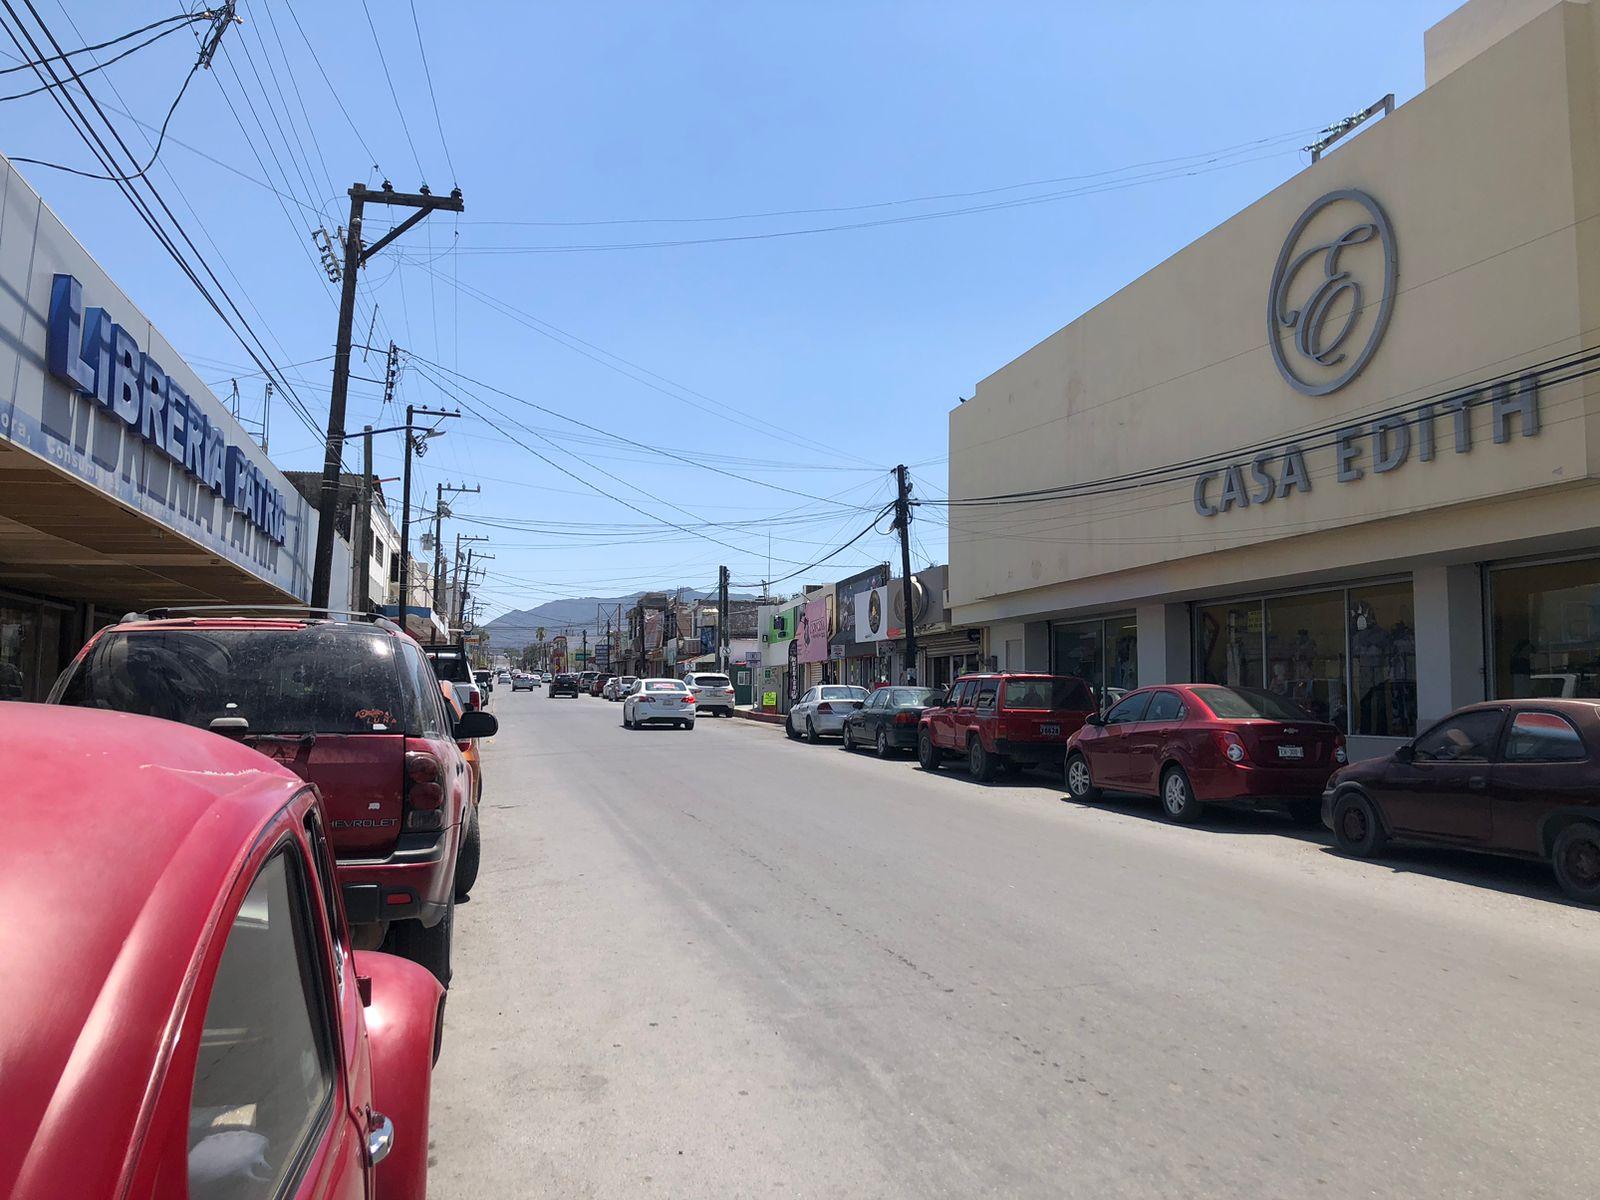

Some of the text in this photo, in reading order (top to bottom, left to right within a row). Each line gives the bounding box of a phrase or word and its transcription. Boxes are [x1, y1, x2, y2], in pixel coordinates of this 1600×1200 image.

[1193, 372, 1542, 517] CASA EDITH
[226, 446, 287, 547] PATRIA
[328, 818, 400, 828] HEVROLET
